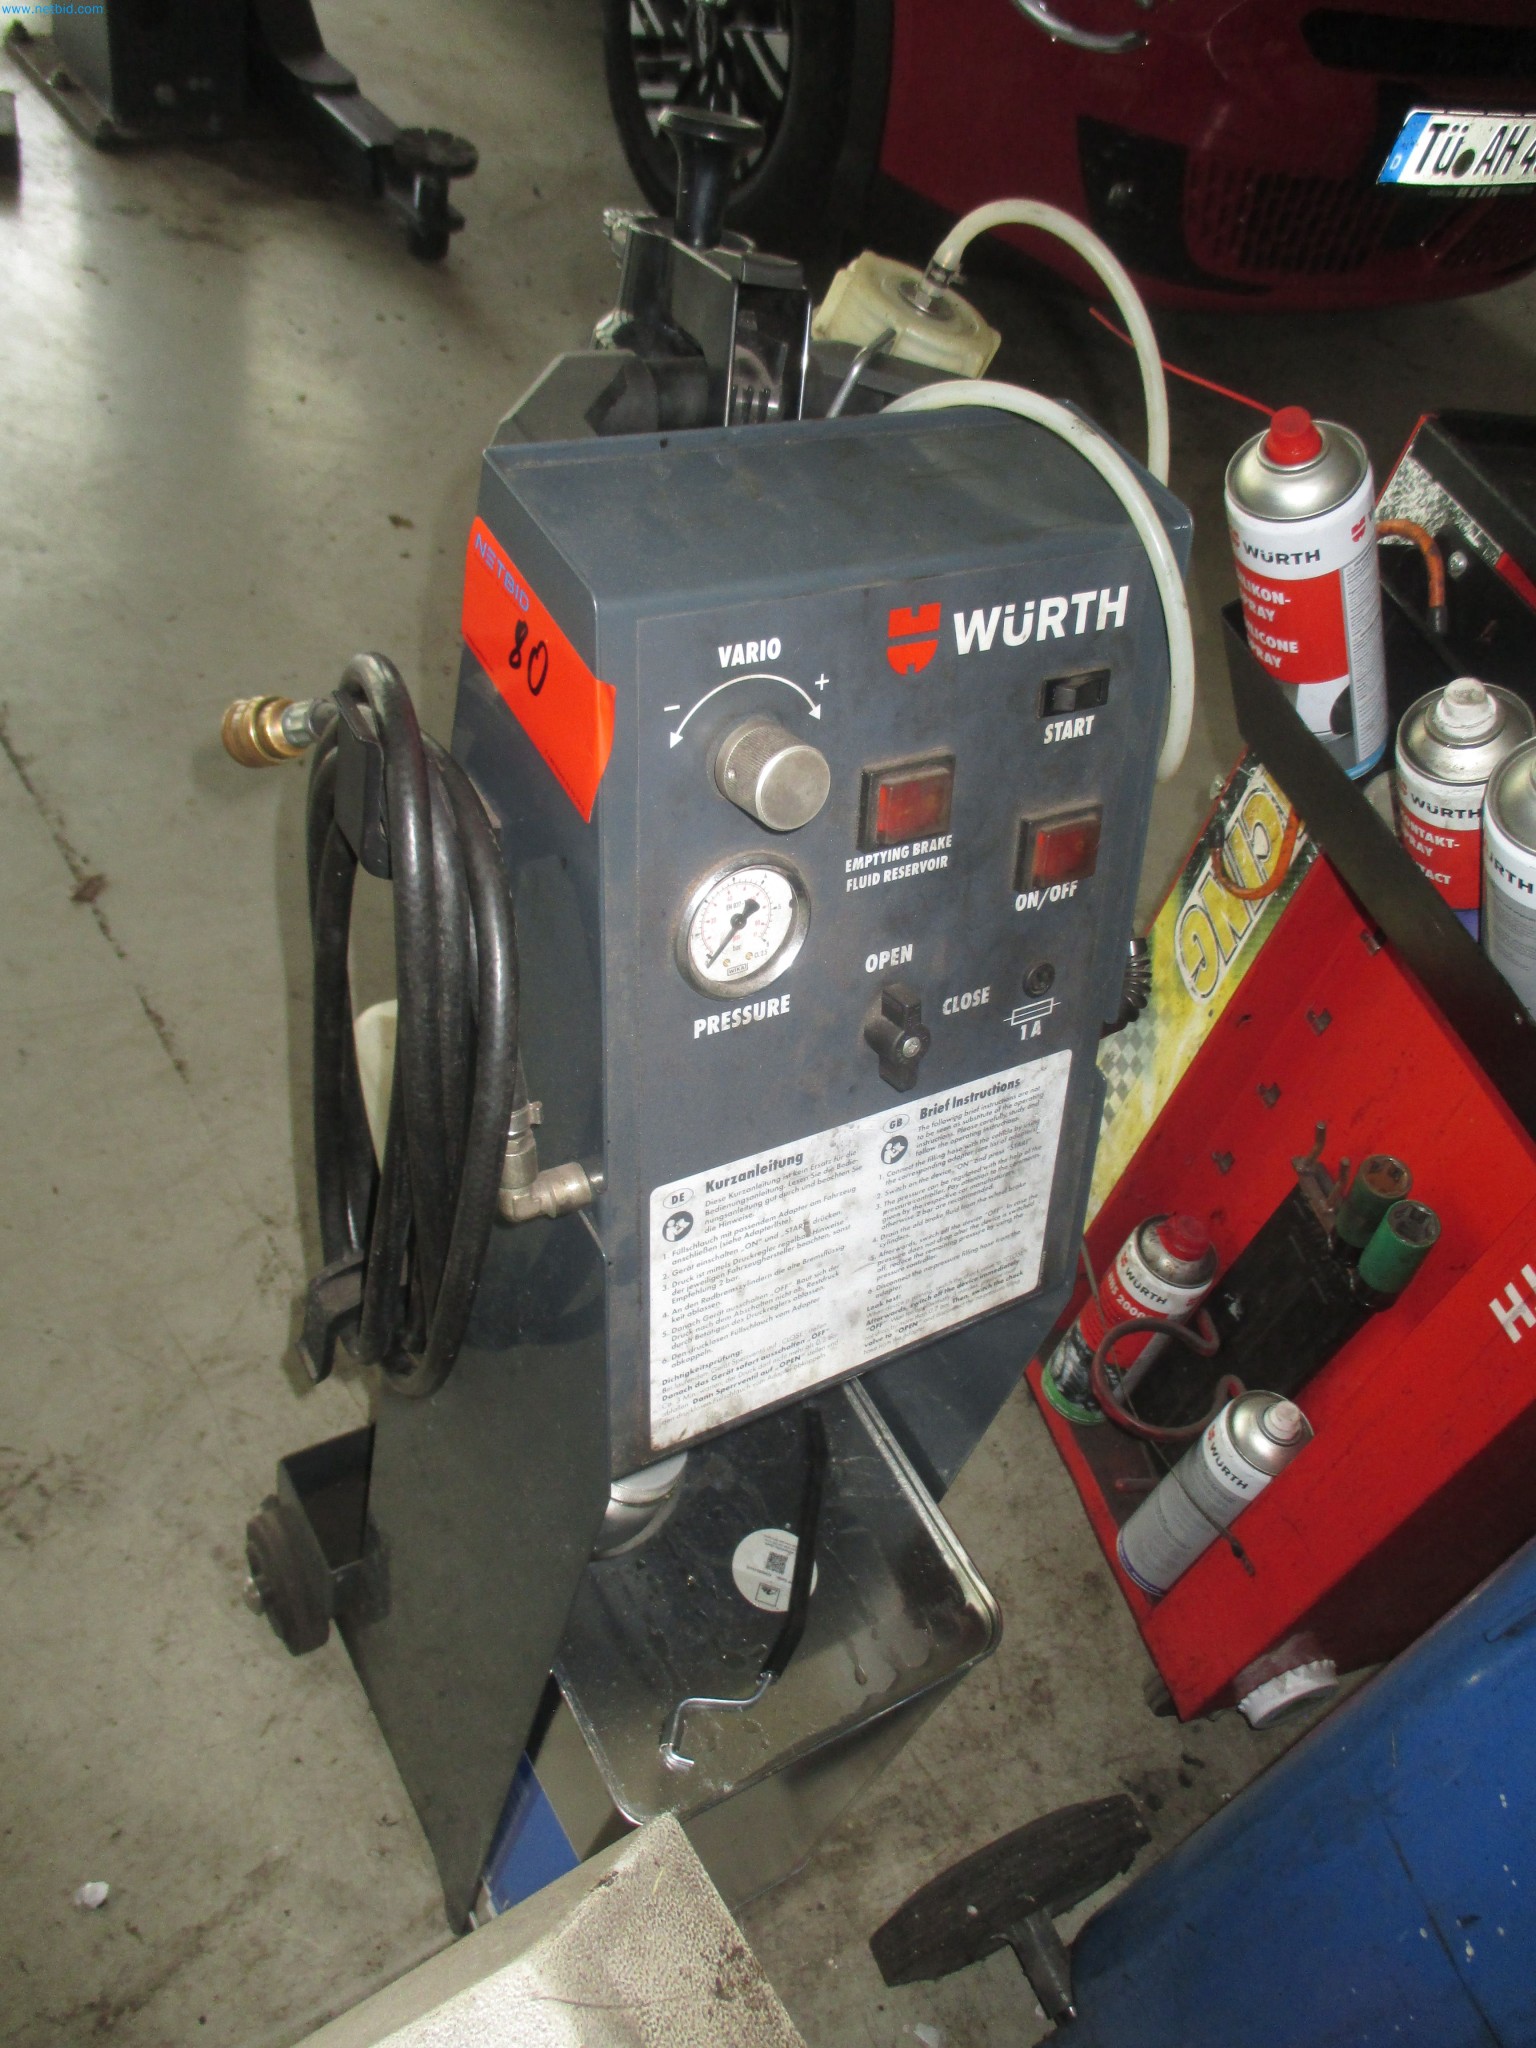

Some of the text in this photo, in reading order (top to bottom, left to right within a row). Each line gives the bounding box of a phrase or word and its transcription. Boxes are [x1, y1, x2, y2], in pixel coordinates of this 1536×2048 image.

[1414, 123, 1469, 175] TÜ
[1472, 125, 1531, 176] AH
[1243, 540, 1321, 566] WÜRTH
[474, 533, 530, 612] NETBID
[953, 585, 1129, 656] WÜRTH
[509, 619, 549, 696] 80
[718, 637, 781, 668] VARIO
[1043, 715, 1095, 744] START
[1411, 793, 1482, 819] WÜRTH
[845, 834, 953, 873] EMPTYING BRAKE
[846, 855, 948, 893] FLUID RESERVOIR
[1015, 880, 1078, 911] ON/OFF
[865, 944, 913, 973] OPEN
[942, 986, 991, 1015] CLOSE
[693, 994, 791, 1040] PRESSURE
[1020, 1020, 1041, 1040] 1 A
[919, 1078, 1020, 1120] Brief Instructions
[888, 1117, 903, 1129] GB
[704, 1195, 726, 1207] Diese
[727, 1176, 781, 1199] Kurzanleitung
[845, 1150, 857, 1159] die
[705, 1153, 803, 1192] Kurzanleitung
[671, 1192, 684, 1205] DE
[671, 1186, 856, 1256] Füllschlauch mit passendem Adapter am Fahrzeug
[704, 1225, 716, 1234] die
[671, 1263, 694, 1277] Gerät
[764, 1231, 779, 1243] und
[671, 1274, 694, 1288] Druck
[732, 1245, 775, 1265] Druckregler
[671, 1283, 717, 1304] Empfehlung
[718, 1278, 724, 1287] 2
[671, 1287, 685, 1296] der
[1488, 1264, 1536, 1343] H
[671, 1307, 683, 1315] An
[684, 1301, 699, 1310] den
[671, 1313, 685, 1323] keit
[671, 1318, 701, 1334] Danach
[702, 1309, 724, 1322] Gerät
[730, 1317, 744, 1326] des
[730, 1315, 773, 1336] Füllschlauch
[661, 1350, 741, 1385] Dichtigkeitsprüfung:
[661, 1384, 693, 1401] Danach
[694, 1378, 709, 1388] das
[710, 1367, 734, 1381] Gerät
[692, 1392, 714, 1404] Dann
[715, 1371, 759, 1395] Sperrventil
[760, 1365, 773, 1376] auf
